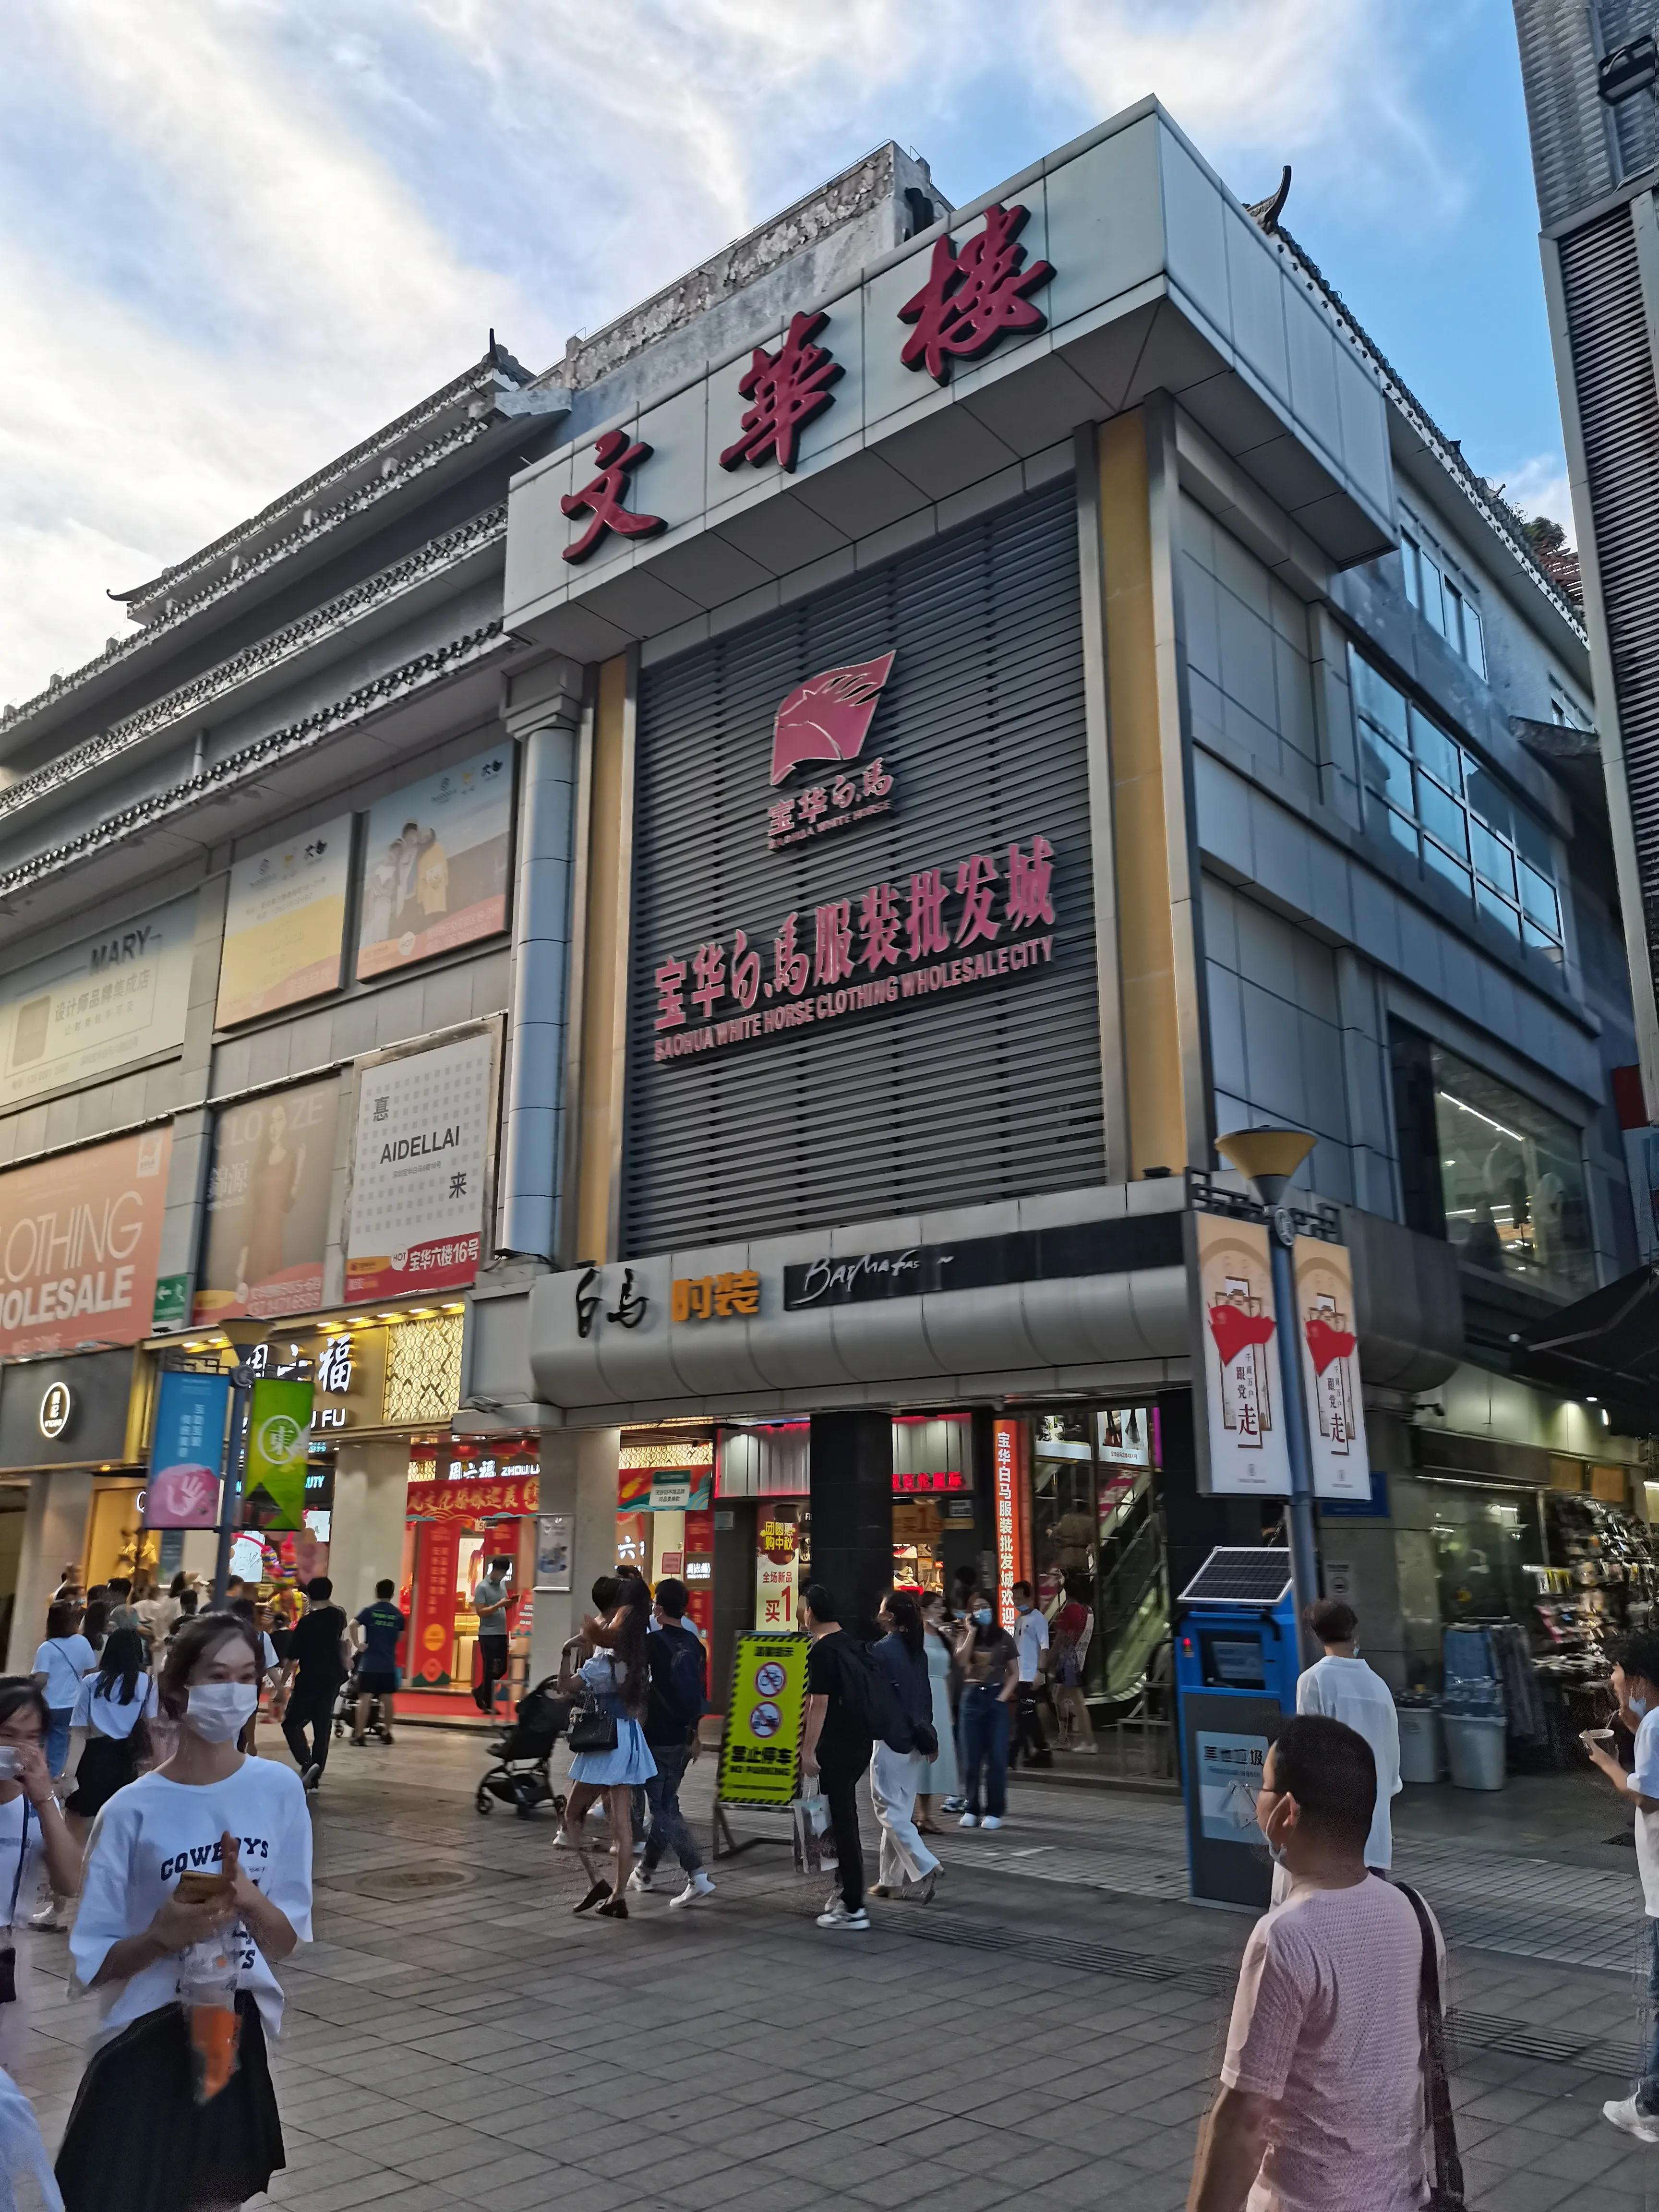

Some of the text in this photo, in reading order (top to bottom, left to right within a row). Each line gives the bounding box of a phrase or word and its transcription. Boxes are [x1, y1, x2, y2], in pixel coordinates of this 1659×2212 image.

[654, 935, 1054, 1061] BAOHUA WHITE HORSE CLOTHING WHOLESALE CITY
[380, 1125, 460, 1164] AIDELLAI
[448, 1171, 467, 1199] 来
[0, 1190, 144, 1283] OTHING
[409, 1238, 479, 1272] 宝华六楼16号
[393, 1251, 406, 1262] HOT
[0, 1265, 135, 1330] OLESALE
[673, 1269, 761, 1322] 时装
[322, 1407, 346, 1428] FU
[762, 1571, 793, 1584] 全场新品
[161, 1837, 269, 1881] COWBYS
